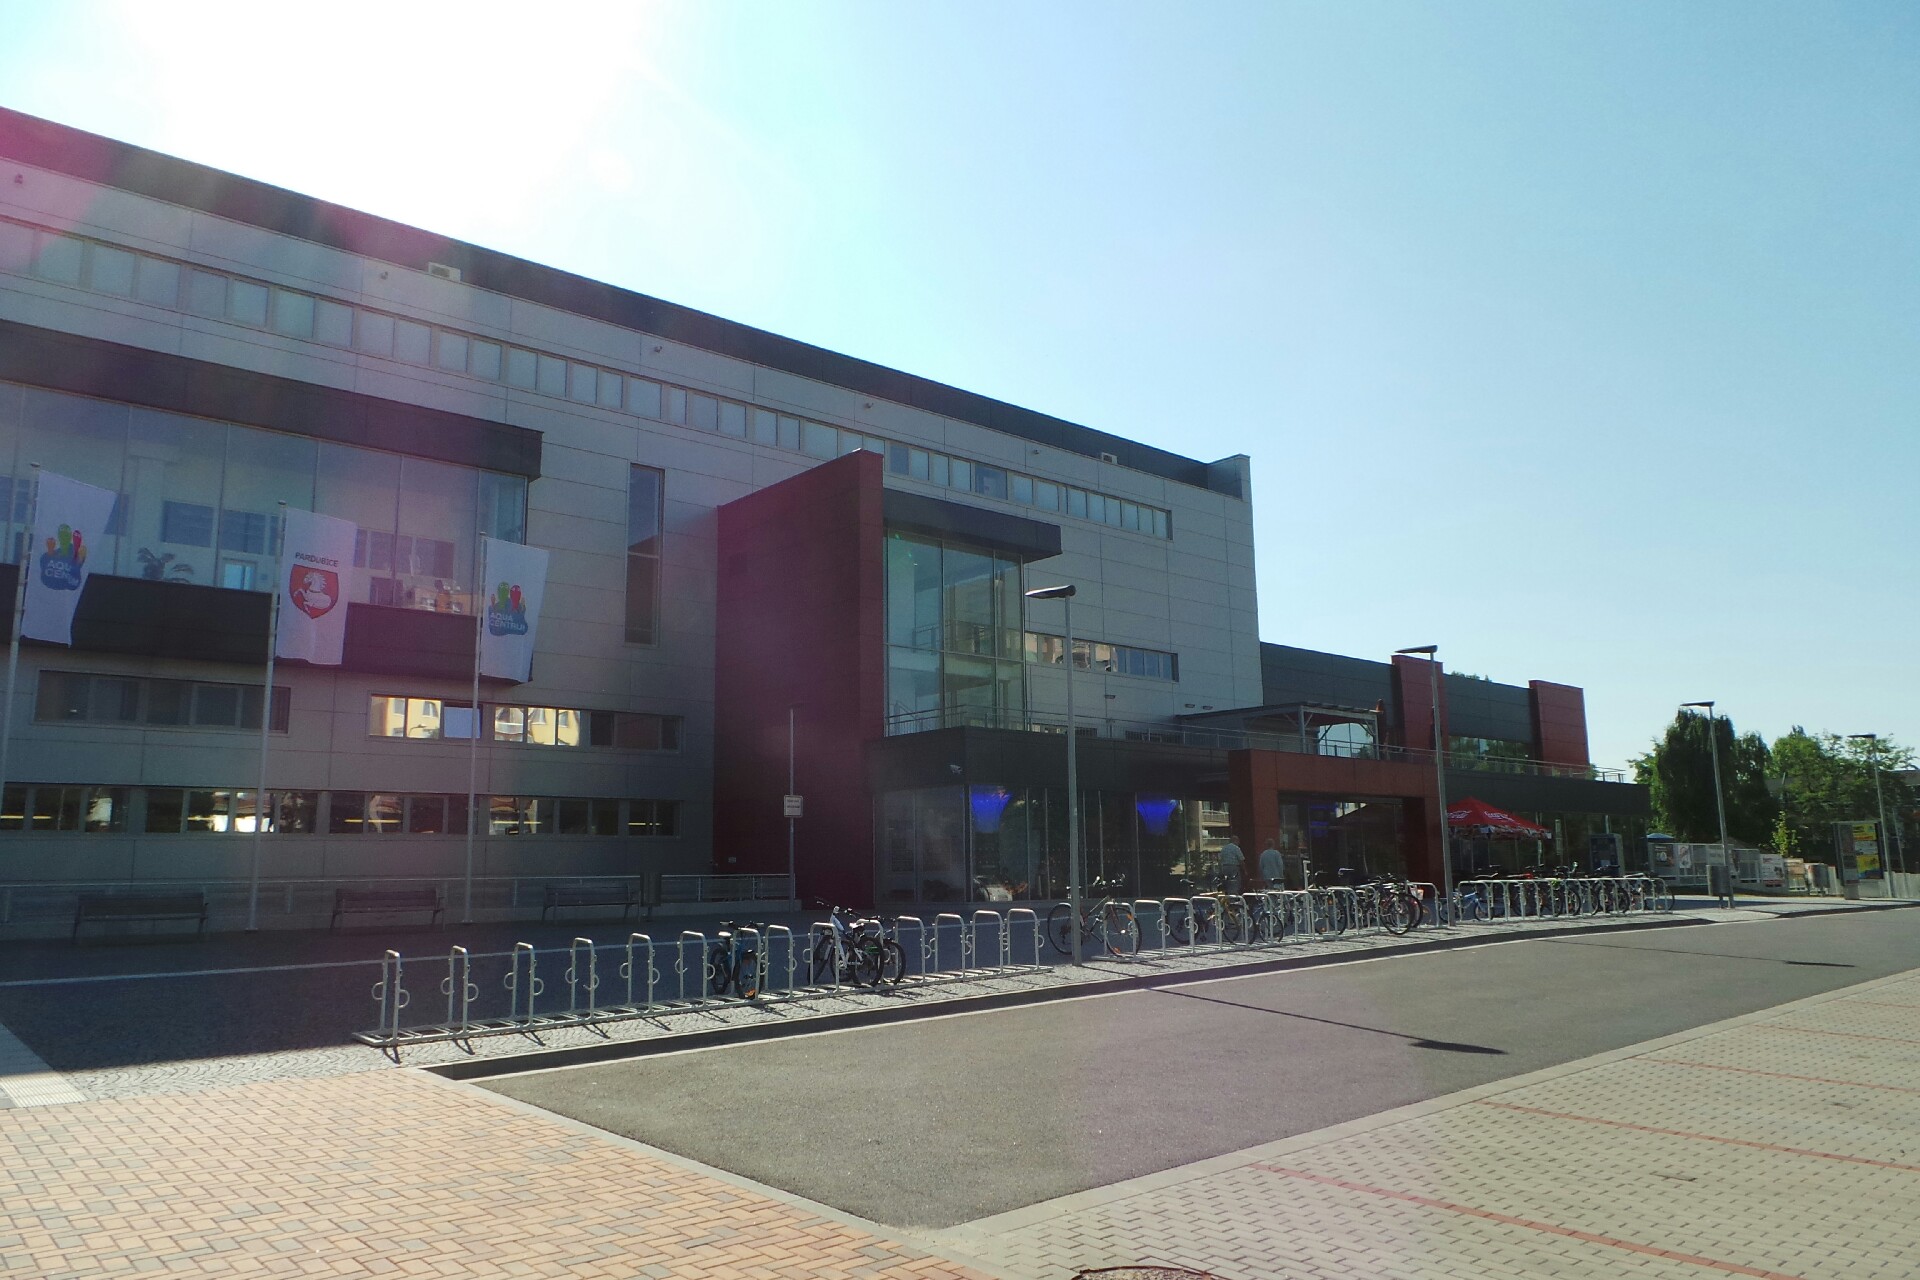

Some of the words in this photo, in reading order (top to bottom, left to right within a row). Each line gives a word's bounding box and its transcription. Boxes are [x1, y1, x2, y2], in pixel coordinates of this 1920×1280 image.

[295, 552, 339, 567] PARDUBICE
[47, 560, 72, 571] AQU
[490, 612, 513, 622] AQUA
